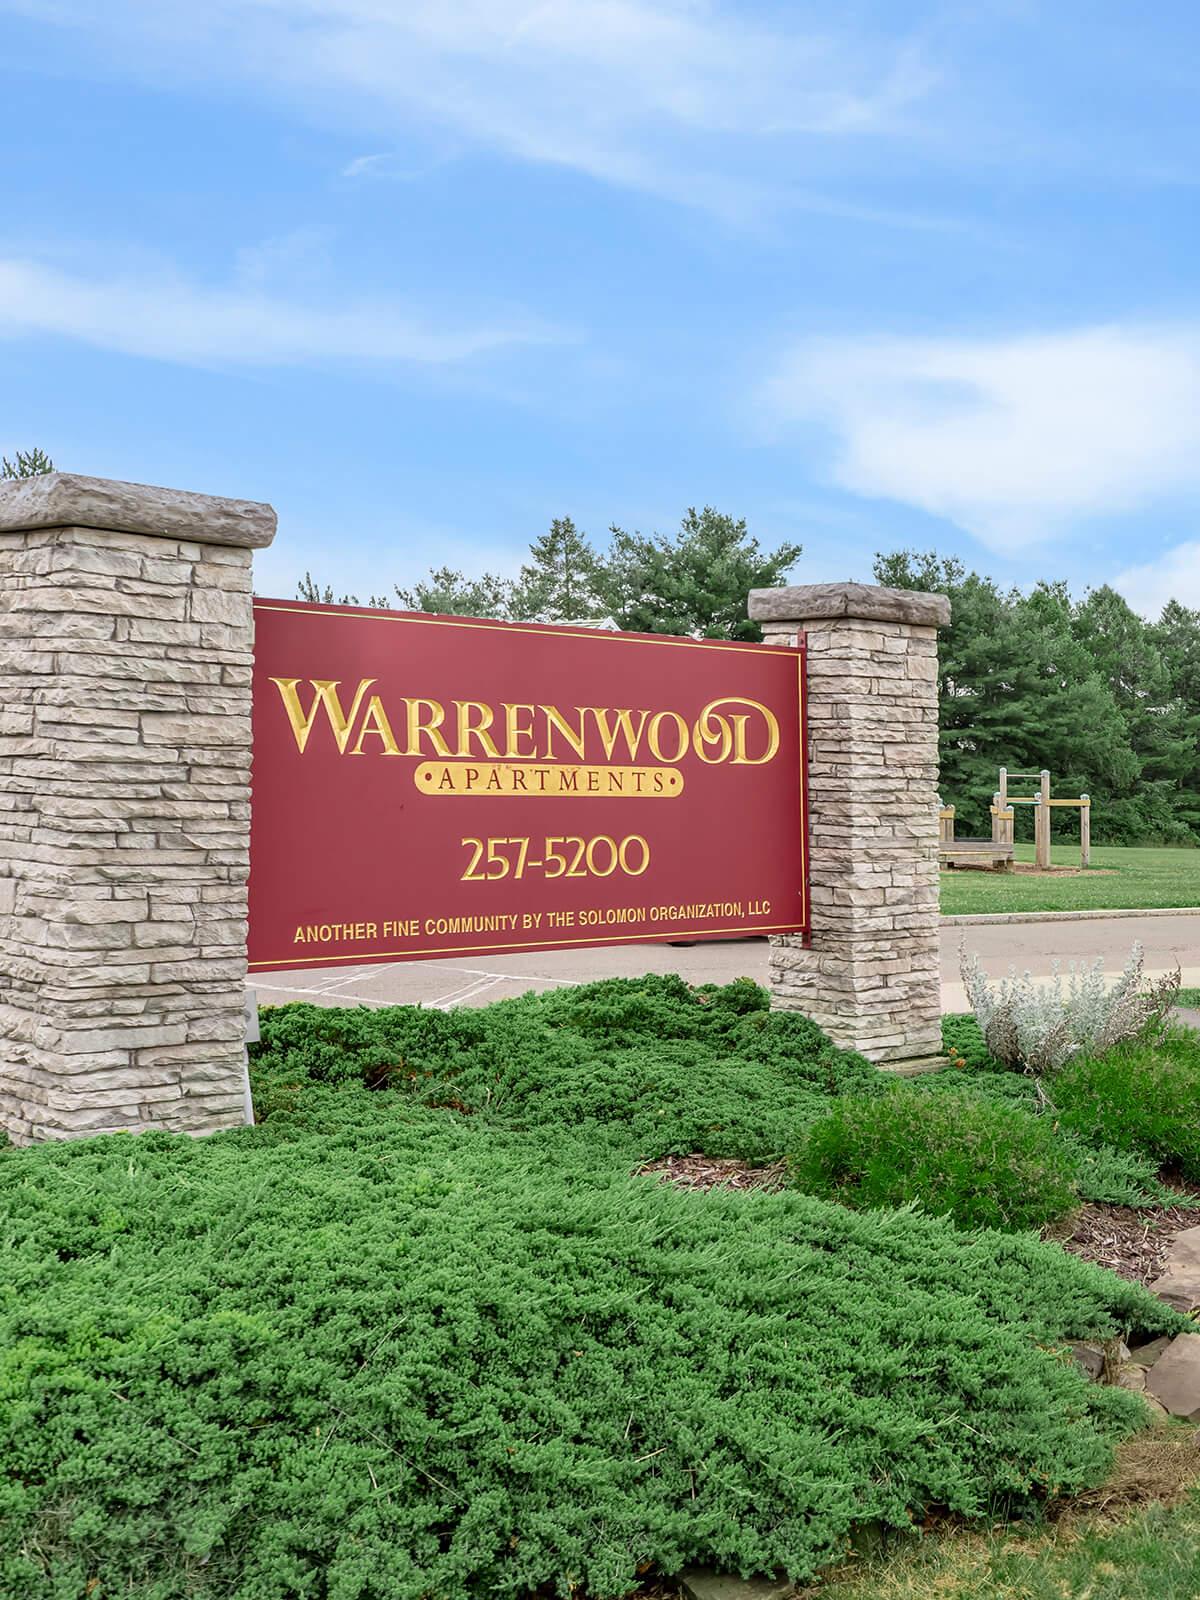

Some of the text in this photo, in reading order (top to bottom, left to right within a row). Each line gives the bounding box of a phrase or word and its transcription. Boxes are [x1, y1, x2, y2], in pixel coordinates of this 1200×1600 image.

[268, 677, 780, 765] WARRENWOOD
[437, 770, 665, 793] APARTMENTS
[459, 834, 651, 881] 257-5200
[293, 900, 771, 944] ANOTHER FINE COMMUNITY BY THE SOLOMON ORGANIZATION, LLC
